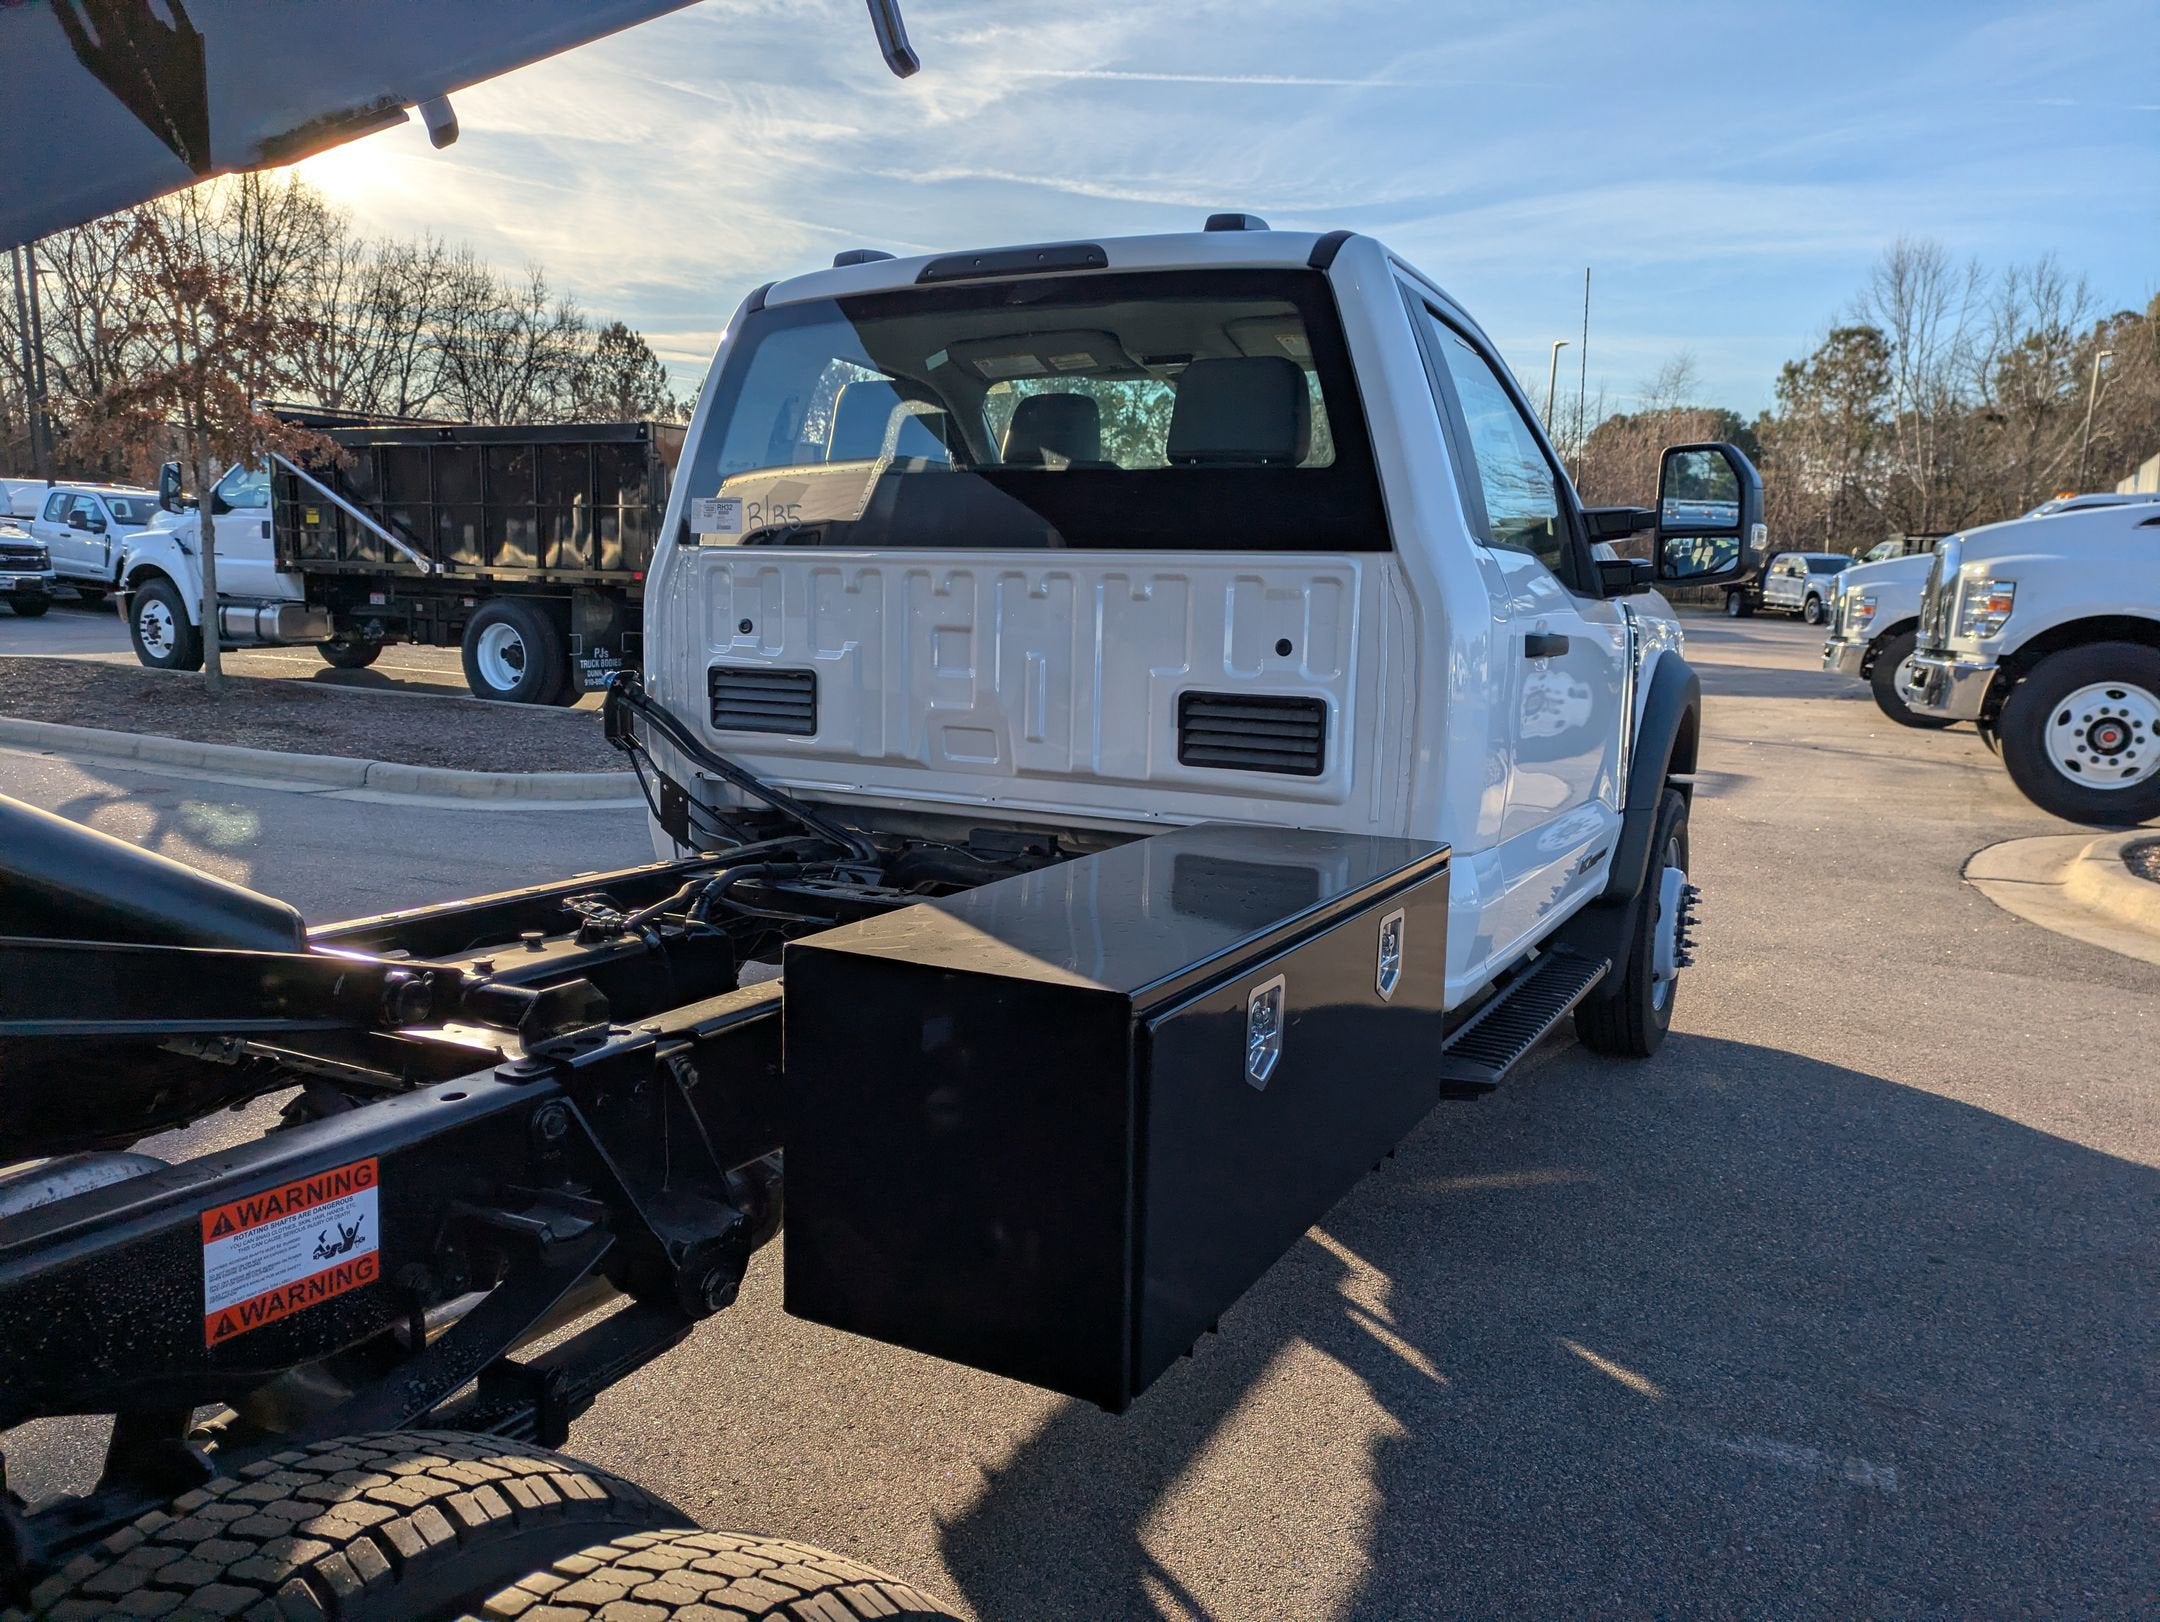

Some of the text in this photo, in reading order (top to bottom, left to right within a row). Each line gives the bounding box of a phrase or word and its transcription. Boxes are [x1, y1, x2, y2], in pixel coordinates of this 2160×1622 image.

[579, 659, 600, 669] TRUCK
[233, 1224, 269, 1243] ROTATING
[270, 1214, 297, 1231] SHAFTS
[297, 1209, 312, 1220] ARE
[312, 1195, 354, 1215] DANGEROUS
[236, 1164, 372, 1227] WARNING
[239, 1256, 373, 1326] WARNING
